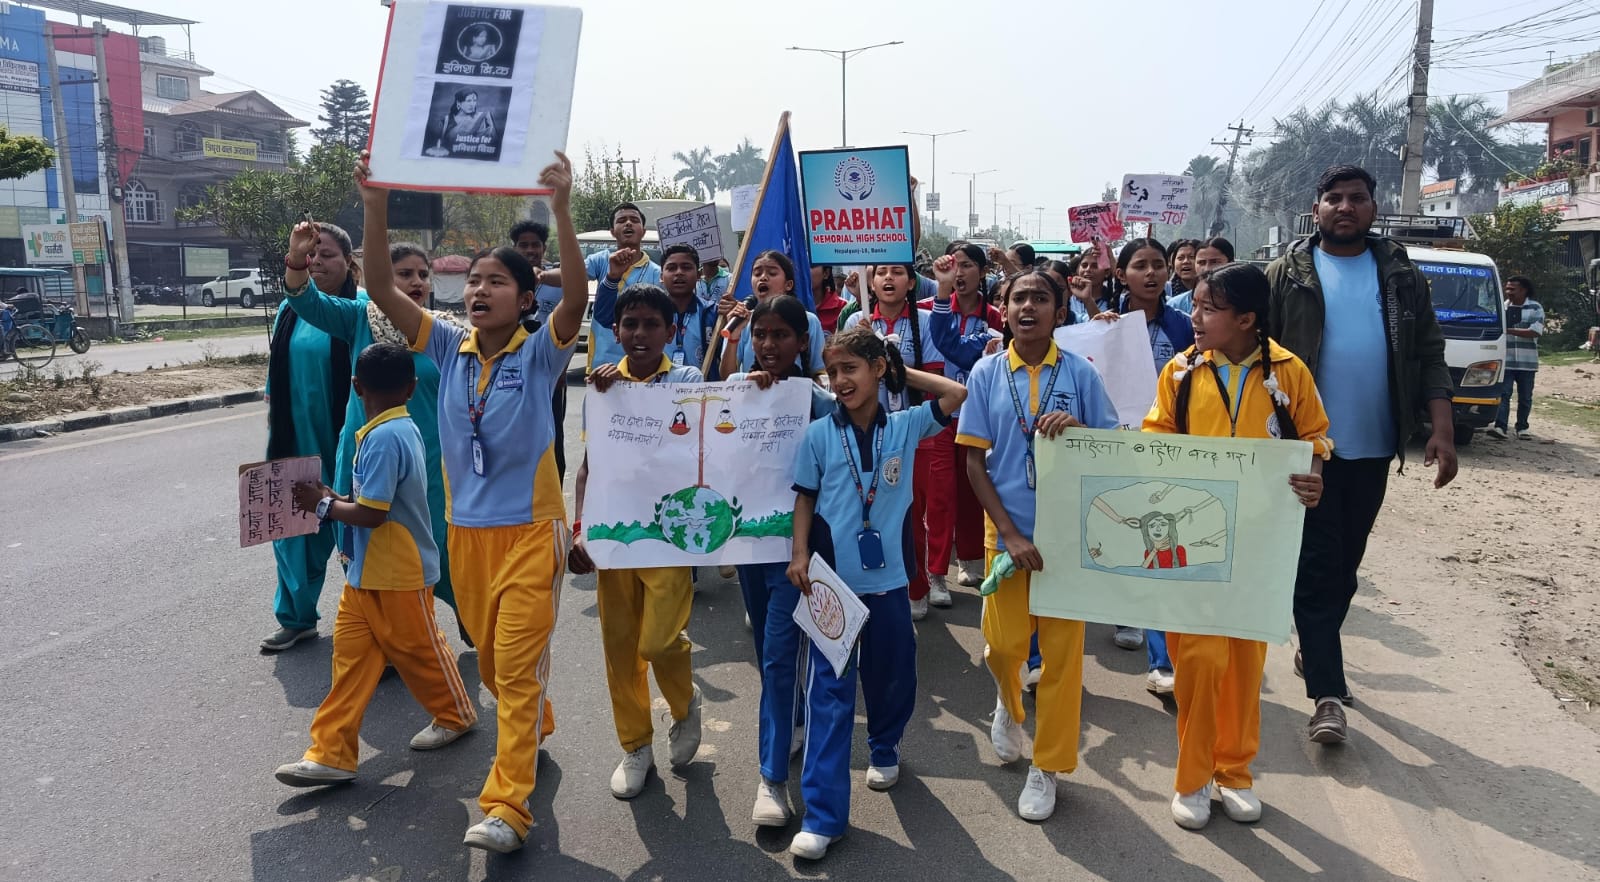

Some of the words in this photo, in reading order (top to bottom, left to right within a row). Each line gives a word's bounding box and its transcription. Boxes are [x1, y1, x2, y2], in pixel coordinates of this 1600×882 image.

[493, 9, 512, 20] FOR
[456, 134, 479, 143] Justice
[481, 135, 492, 144] for
[810, 206, 907, 231] PRABHAT
[813, 234, 854, 243] MEMORIAL
[856, 233, 877, 243] HIGH
[877, 233, 907, 242] SCHOOL
[1065, 435, 1126, 459] महिला
